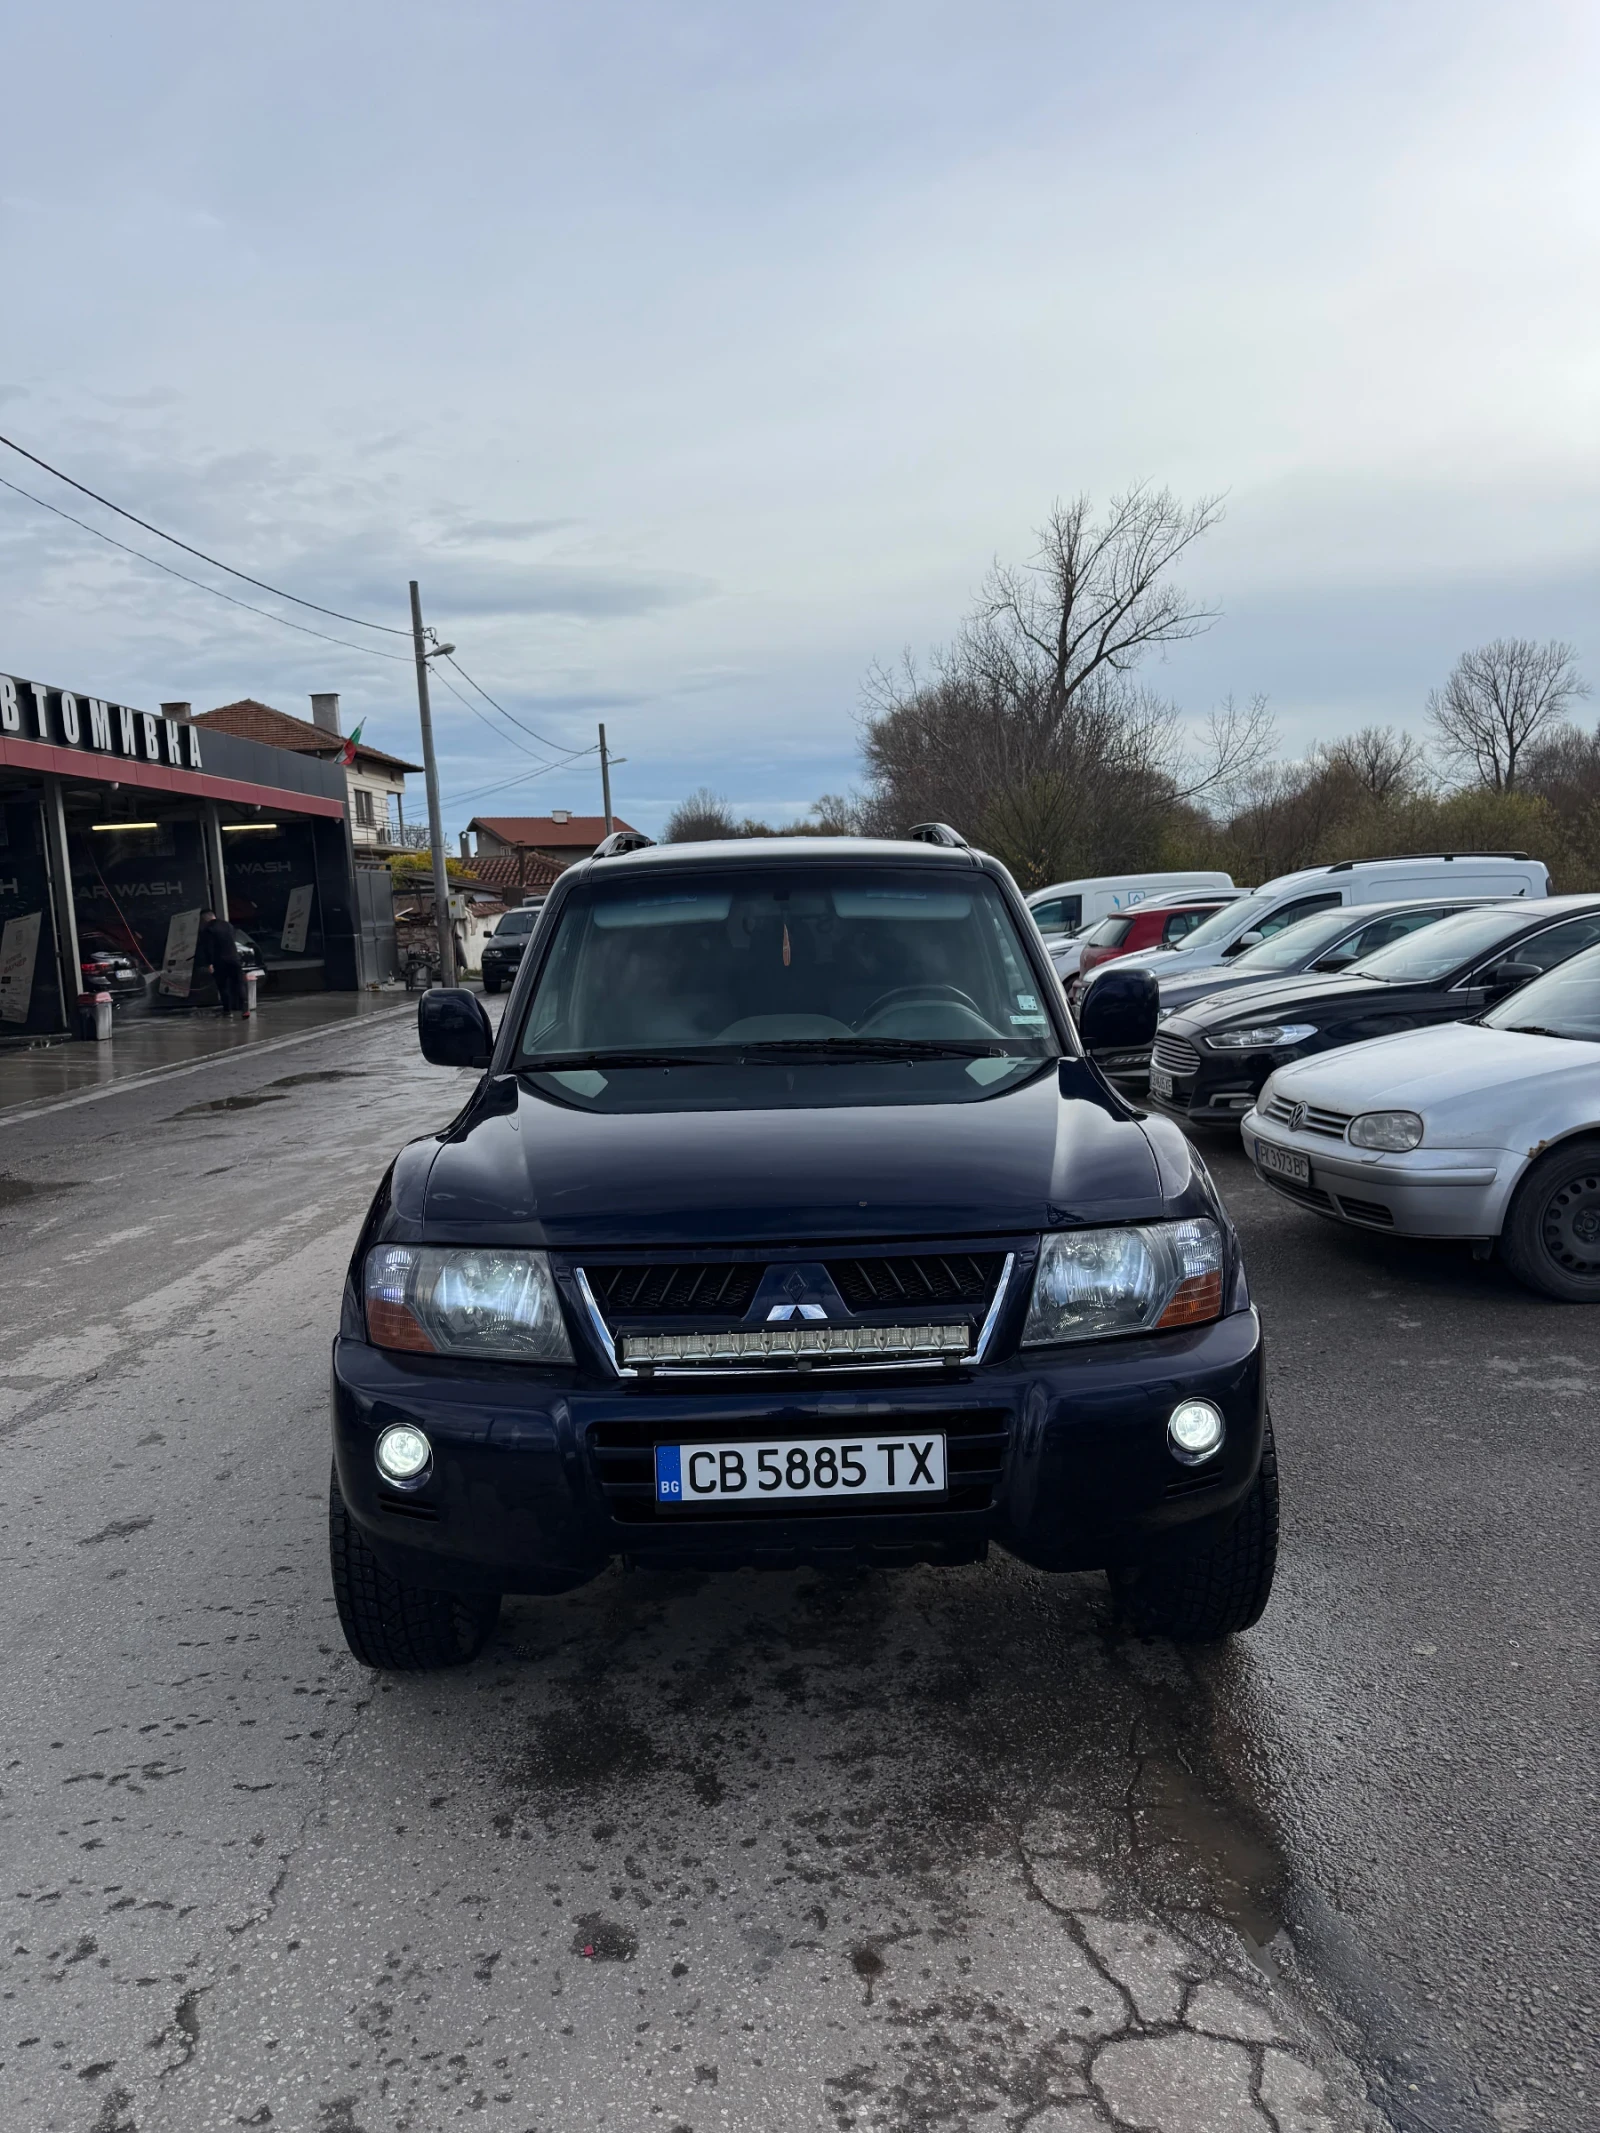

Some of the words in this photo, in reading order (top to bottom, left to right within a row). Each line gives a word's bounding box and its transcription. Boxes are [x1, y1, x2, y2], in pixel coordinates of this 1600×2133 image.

[234, 860, 291, 874] WASH
[73, 885, 108, 900] AR
[114, 880, 183, 898] WASH
[1293, 1156, 1308, 1178] BC
[689, 1450, 747, 1494] CB
[757, 1445, 867, 1491] 5885
[877, 1441, 935, 1486] TX
[661, 1480, 680, 1494] BG
